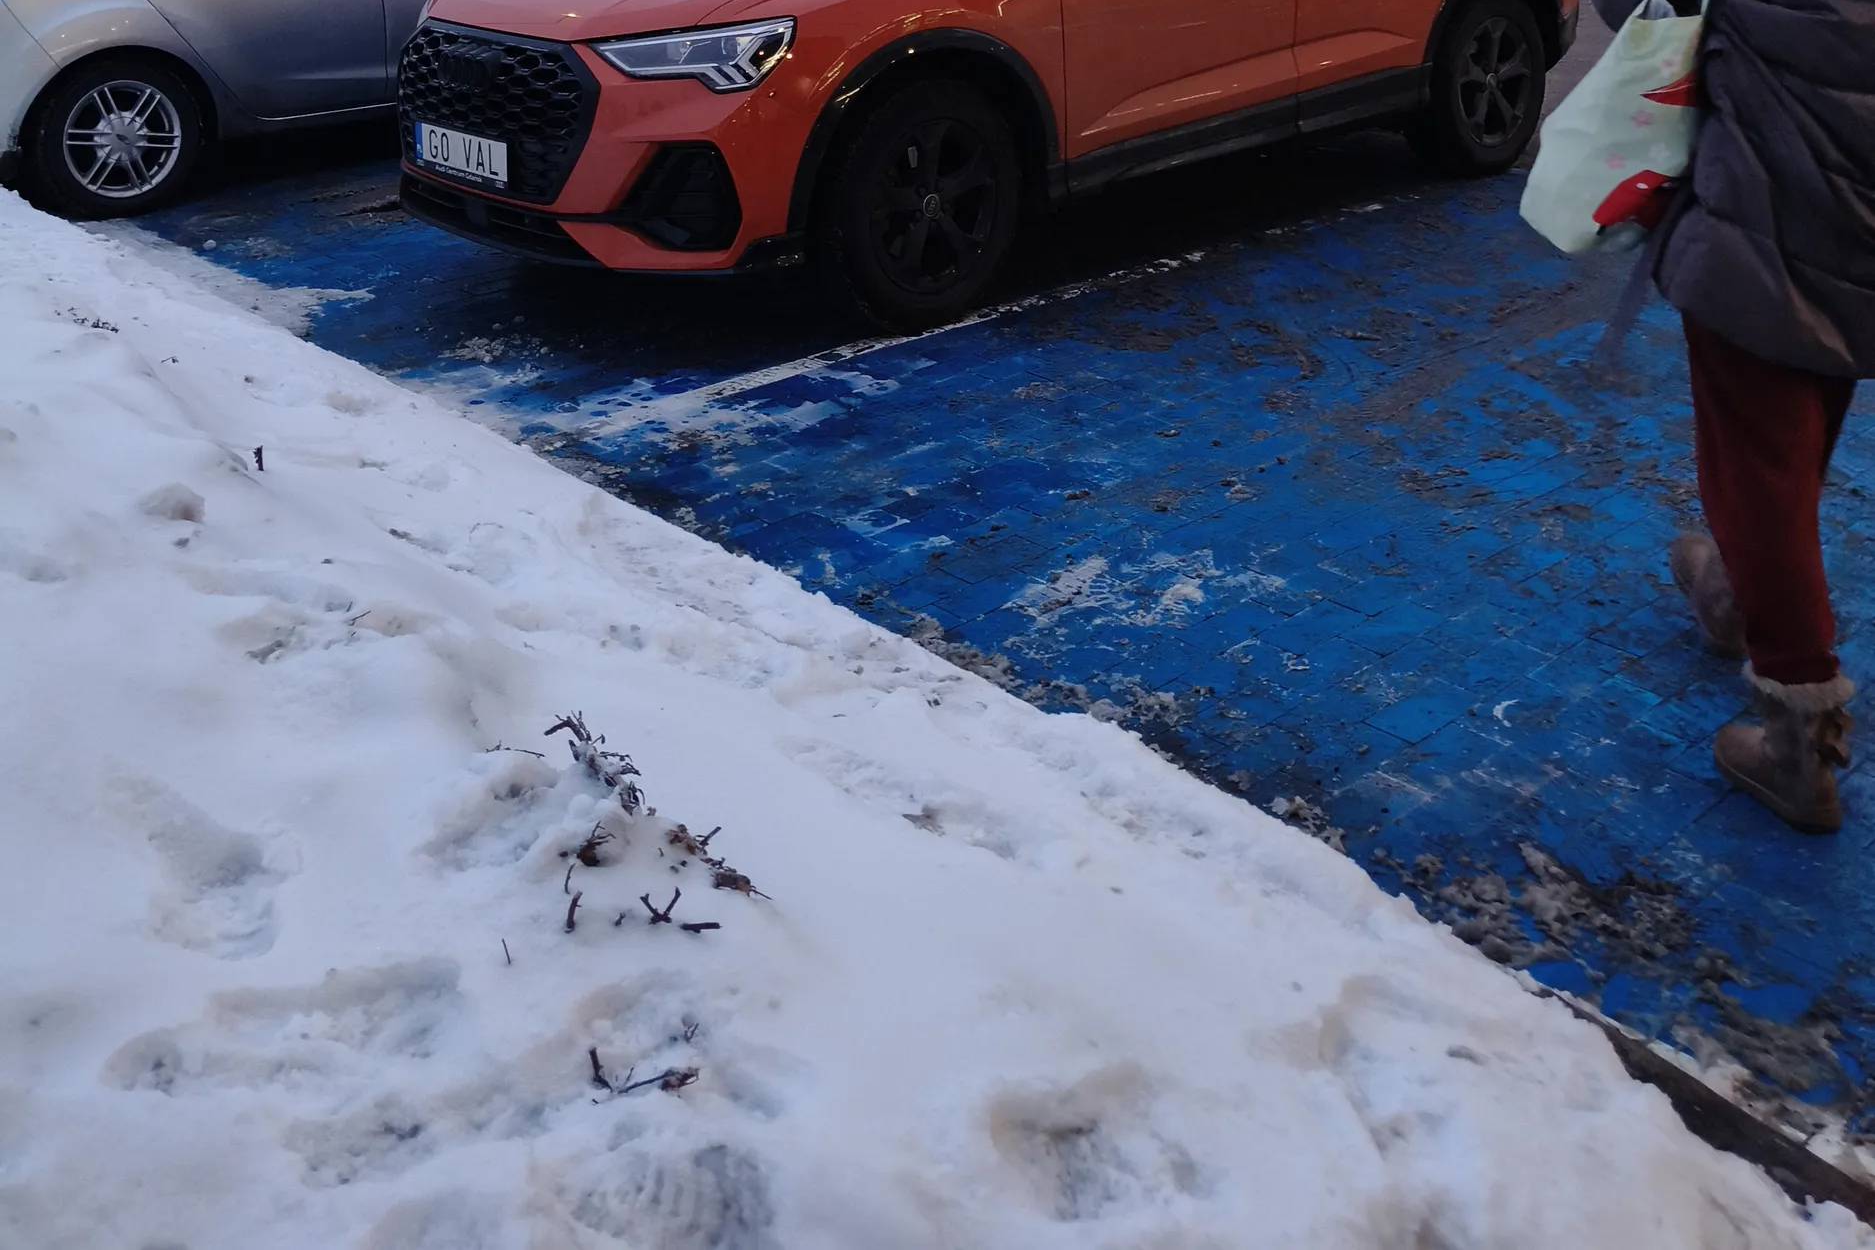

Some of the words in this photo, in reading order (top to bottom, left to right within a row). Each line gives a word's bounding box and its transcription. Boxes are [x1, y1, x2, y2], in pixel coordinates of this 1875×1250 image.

[416, 144, 423, 153] PL
[428, 129, 450, 162] GO
[462, 137, 499, 177] VAL
[435, 165, 445, 173] Audi
